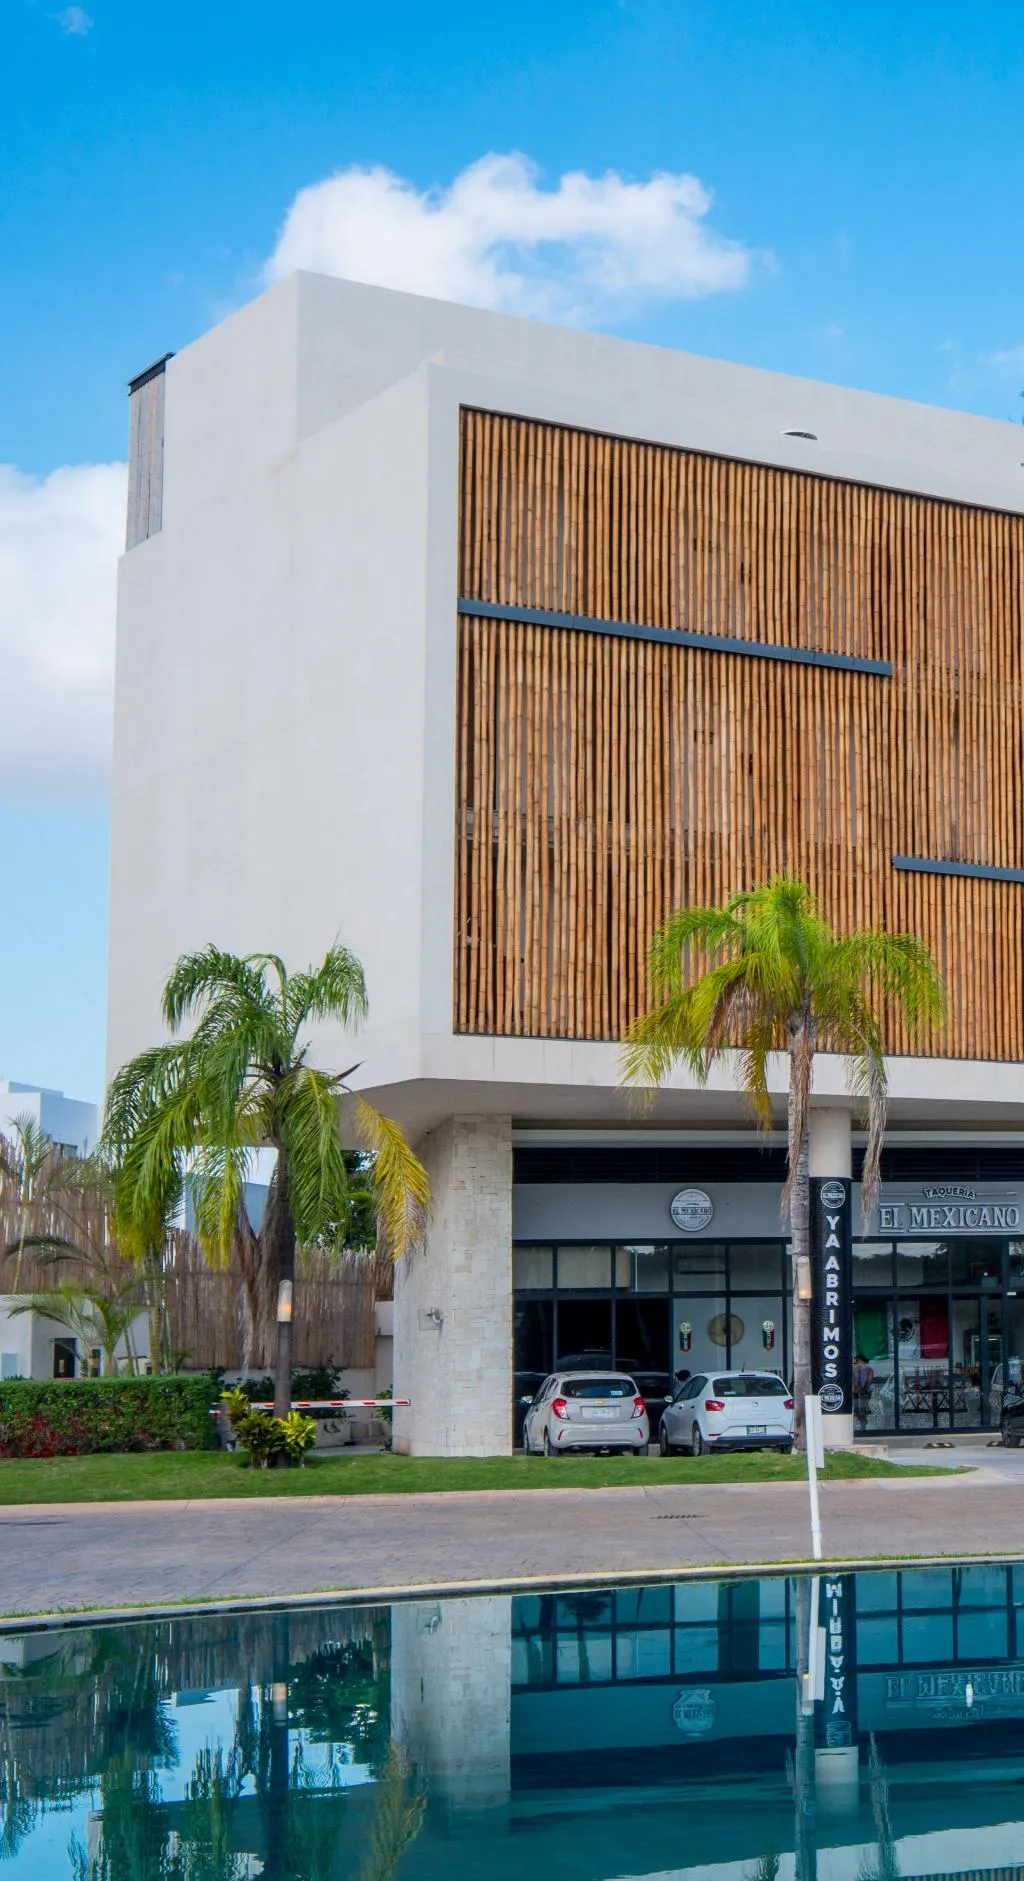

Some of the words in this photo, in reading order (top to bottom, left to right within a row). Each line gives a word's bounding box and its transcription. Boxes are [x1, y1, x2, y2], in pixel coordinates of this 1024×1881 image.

[924, 1187, 975, 1199] TAQUERÍA
[880, 1208, 904, 1228] EL
[910, 1206, 1020, 1228] MEXICANO
[826, 1215, 840, 1248] YA
[823, 1255, 840, 1379] ABRIMOS
